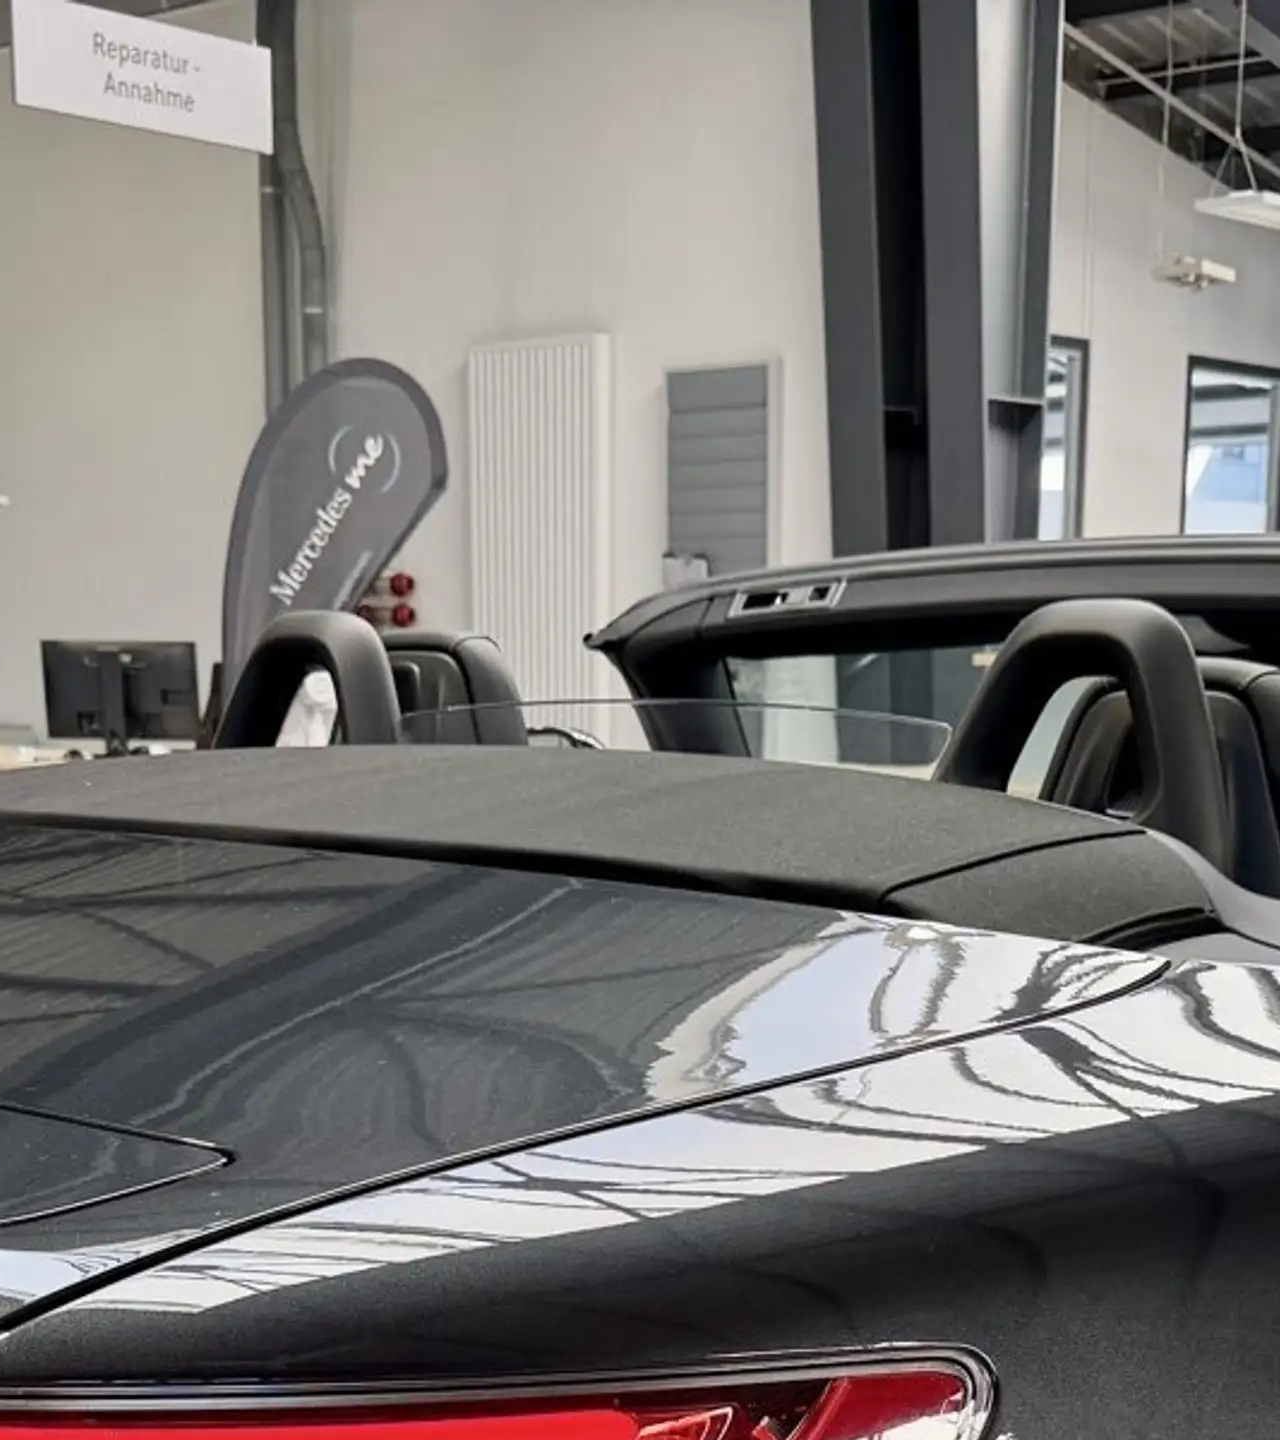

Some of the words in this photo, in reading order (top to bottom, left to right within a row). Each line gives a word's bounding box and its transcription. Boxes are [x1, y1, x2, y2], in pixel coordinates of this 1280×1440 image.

[103, 72, 195, 112] Annahme
[270, 487, 352, 606] Mercedes
[345, 434, 384, 489] me
